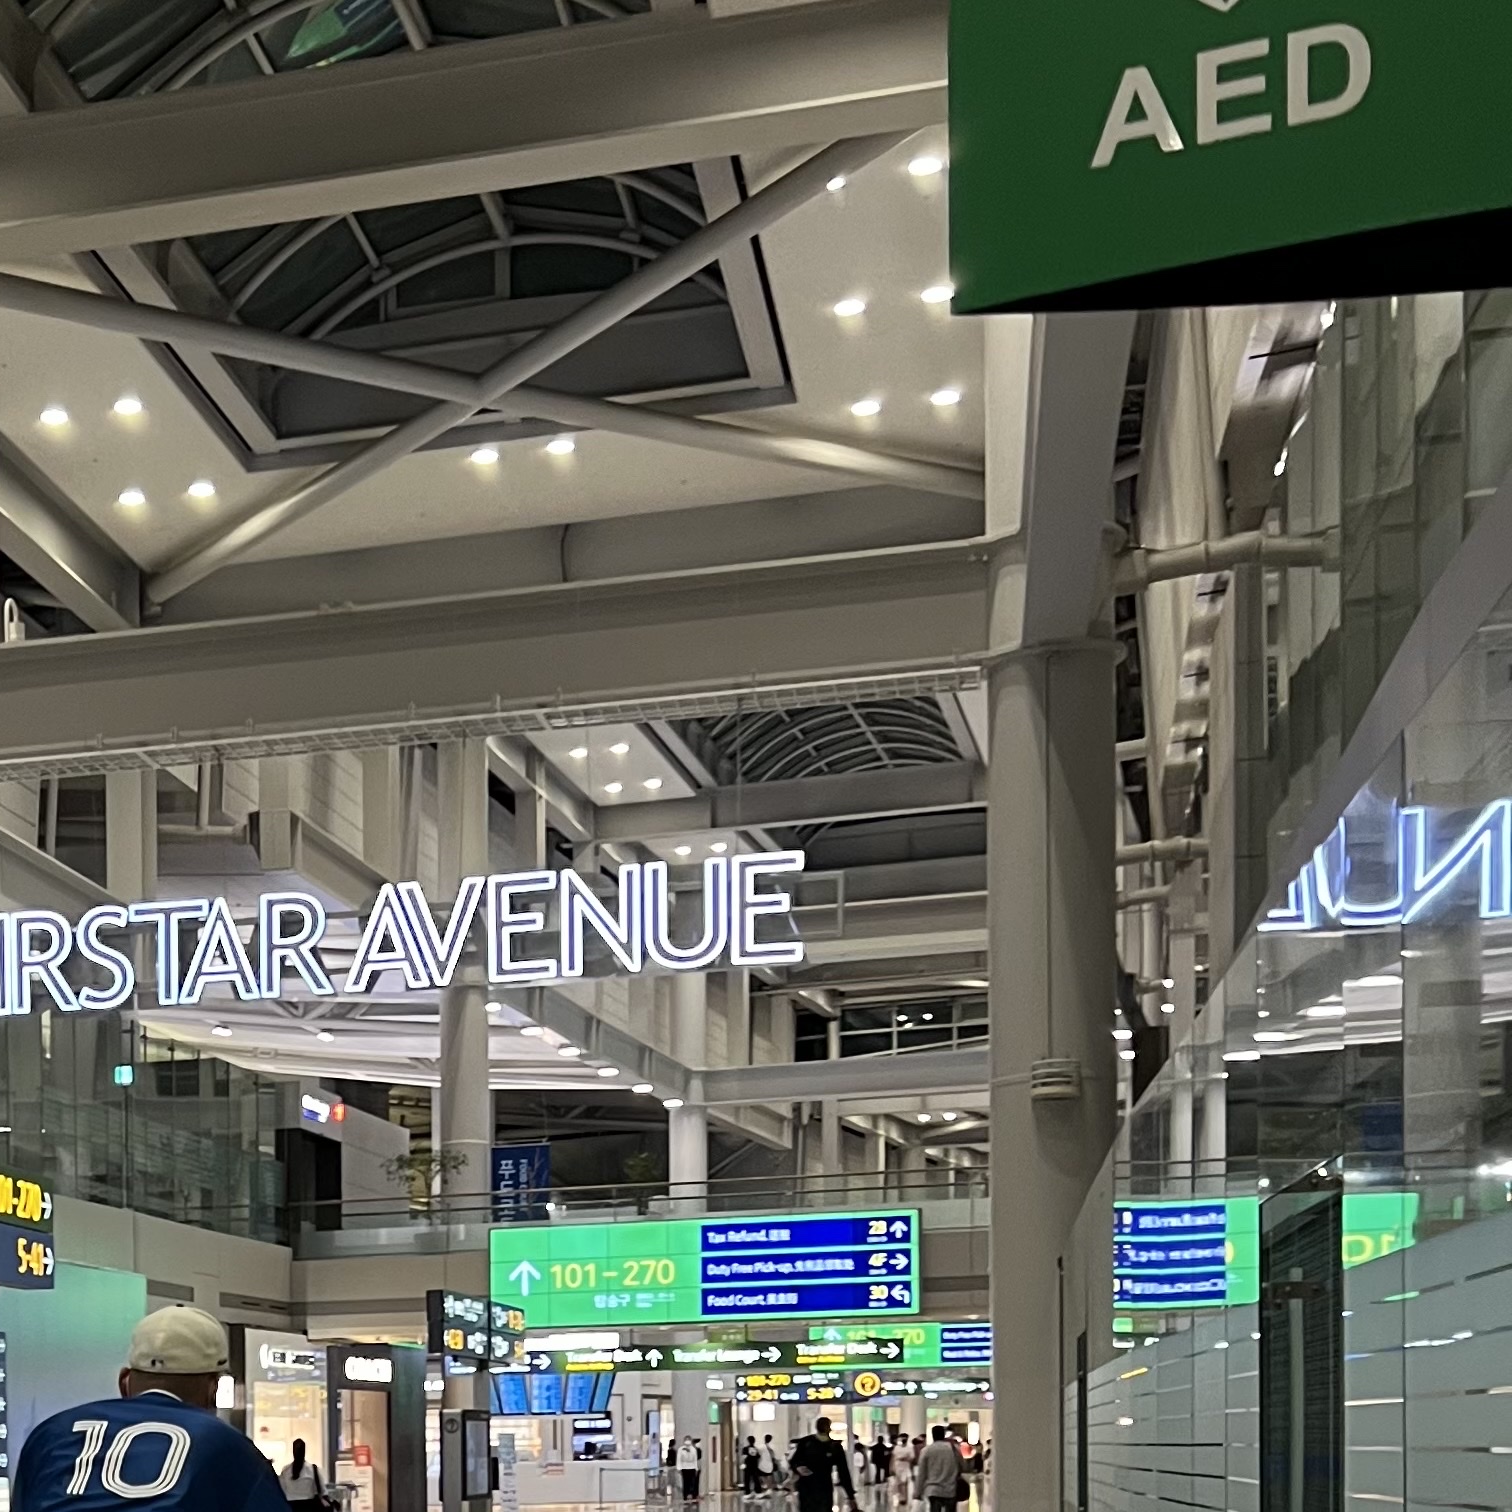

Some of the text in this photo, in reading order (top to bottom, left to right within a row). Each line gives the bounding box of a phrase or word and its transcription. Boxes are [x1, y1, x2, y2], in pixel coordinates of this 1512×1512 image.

[1091, 23, 1371, 168] AED
[345, 850, 806, 988] AVENUE
[66, 1420, 191, 1499] 10
